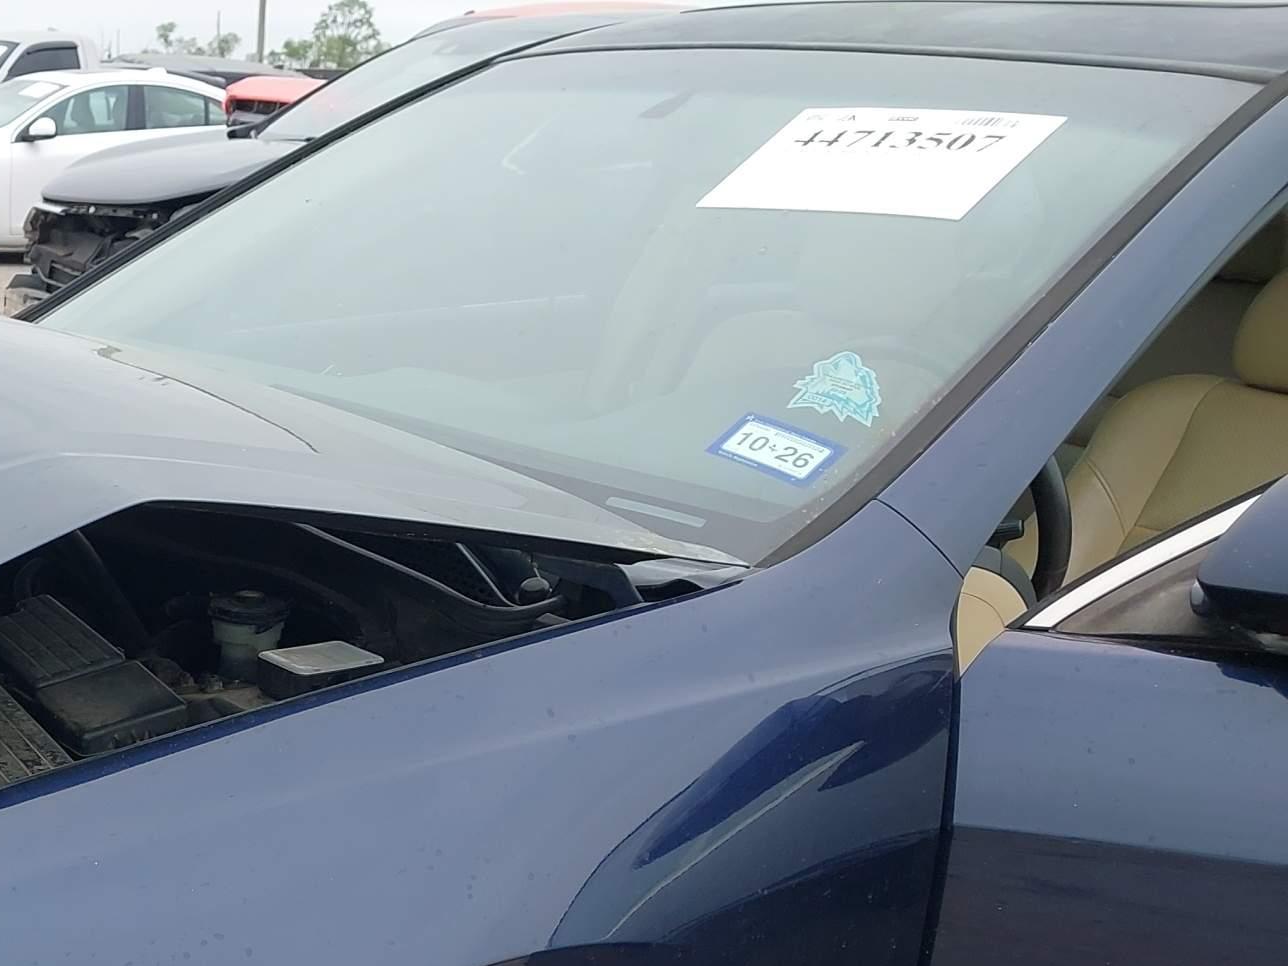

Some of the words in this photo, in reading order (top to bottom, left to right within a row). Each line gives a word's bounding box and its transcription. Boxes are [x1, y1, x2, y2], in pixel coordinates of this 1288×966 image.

[794, 129, 1007, 152] 44713507
[737, 432, 770, 452] 10
[774, 446, 815, 469] 26
